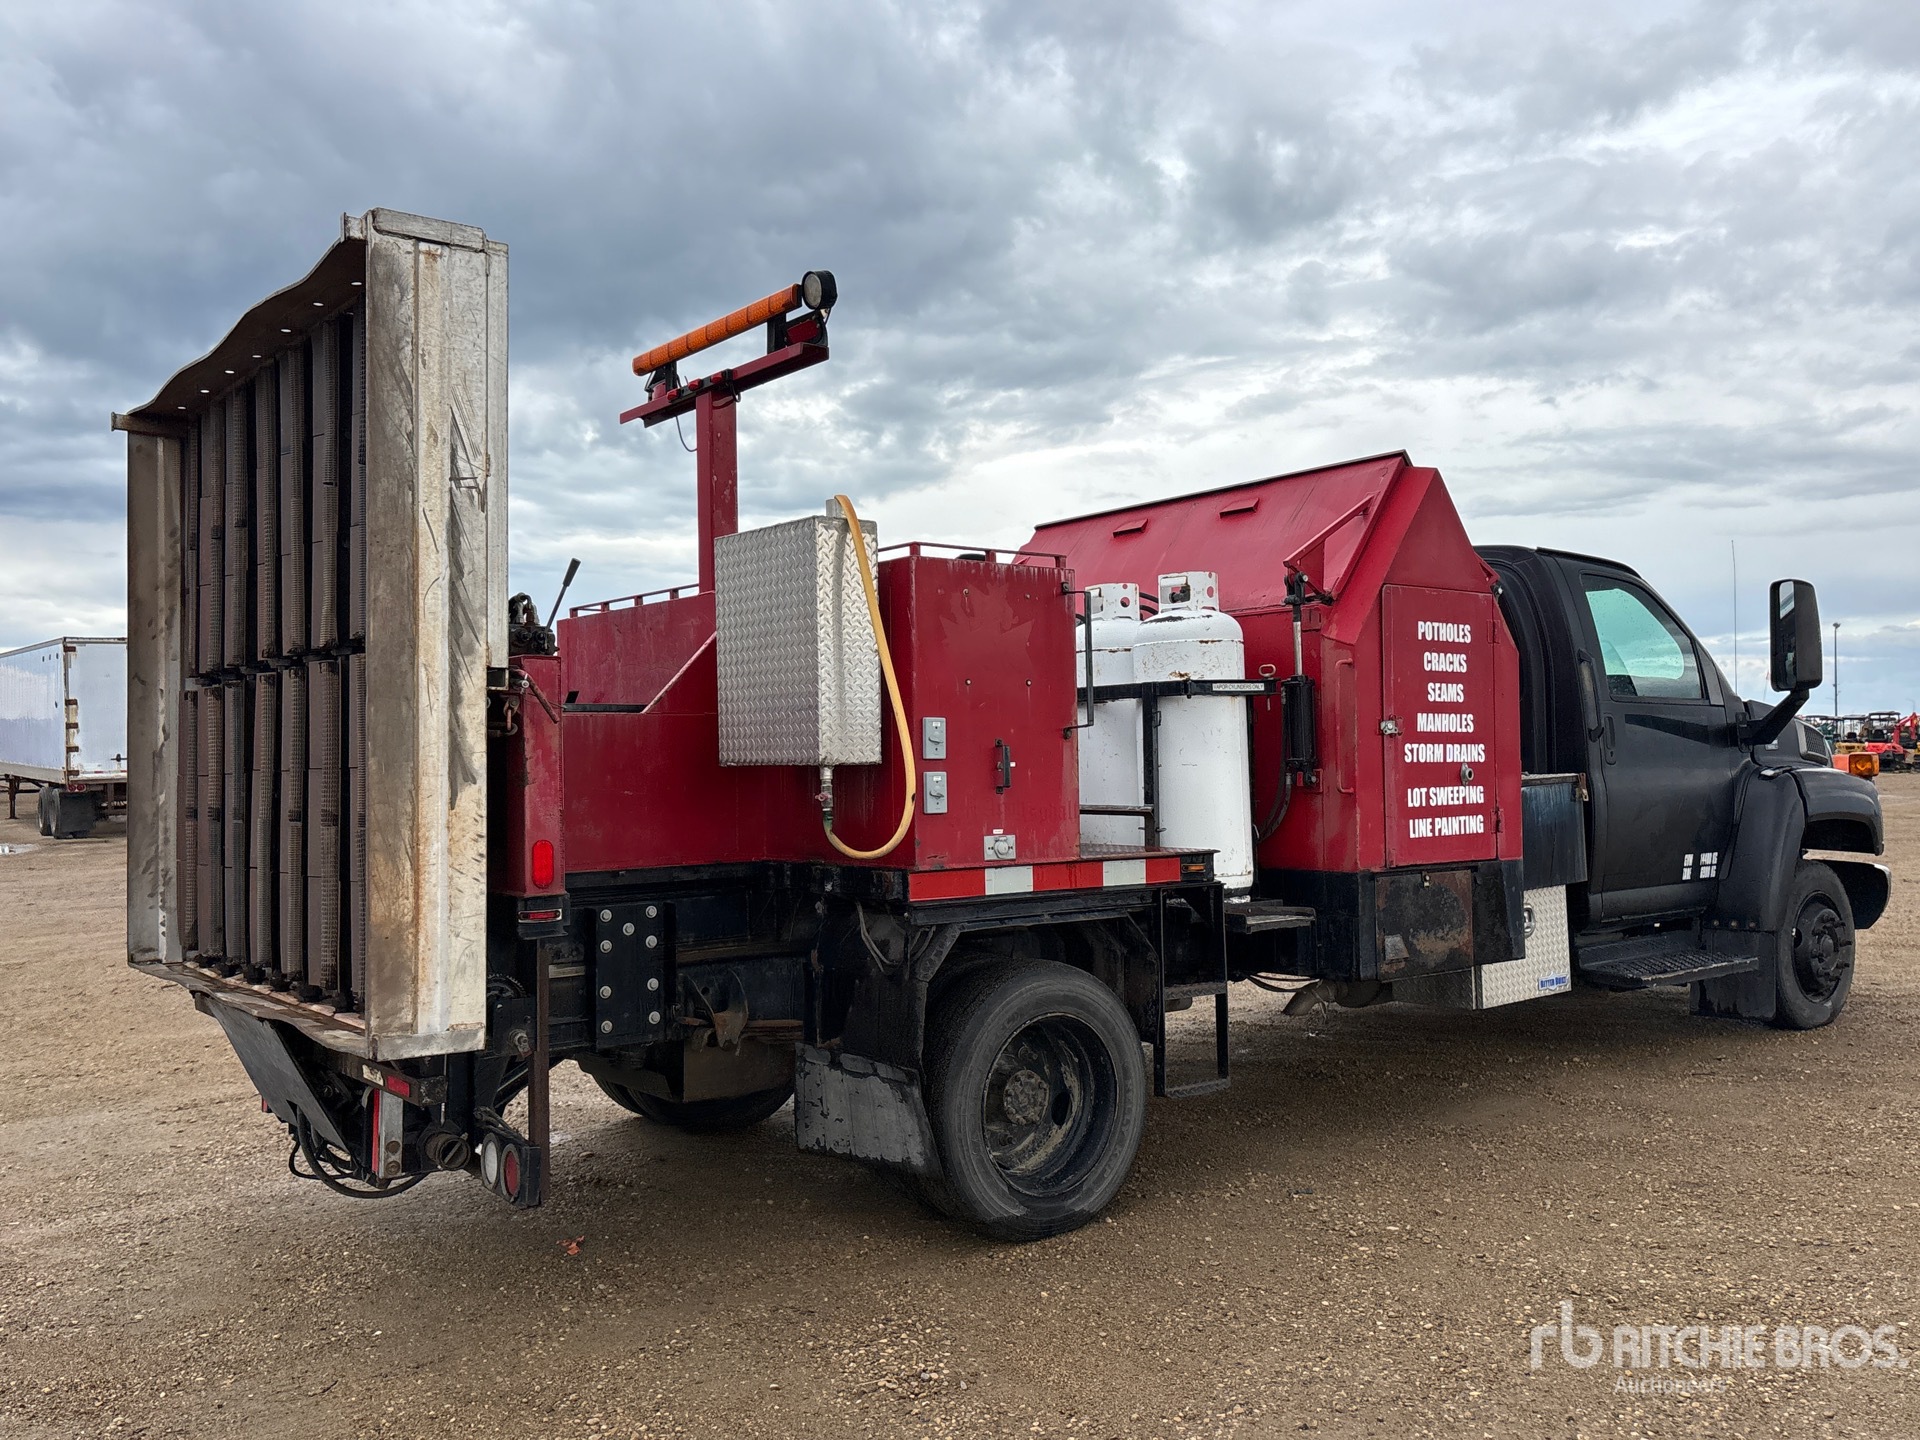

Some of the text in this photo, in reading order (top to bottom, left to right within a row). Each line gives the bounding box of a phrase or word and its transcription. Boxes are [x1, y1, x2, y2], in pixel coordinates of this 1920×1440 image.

[1417, 620, 1472, 644] POTHOLES
[1423, 651, 1467, 673] CRACKS
[1427, 682, 1464, 703] SEAMS
[1416, 712, 1475, 733] MANHOLES
[1404, 743, 1486, 763] STORM DRAINS
[1407, 785, 1485, 808] LOT SWEEPING
[1409, 814, 1485, 839] LINE PAINTING
